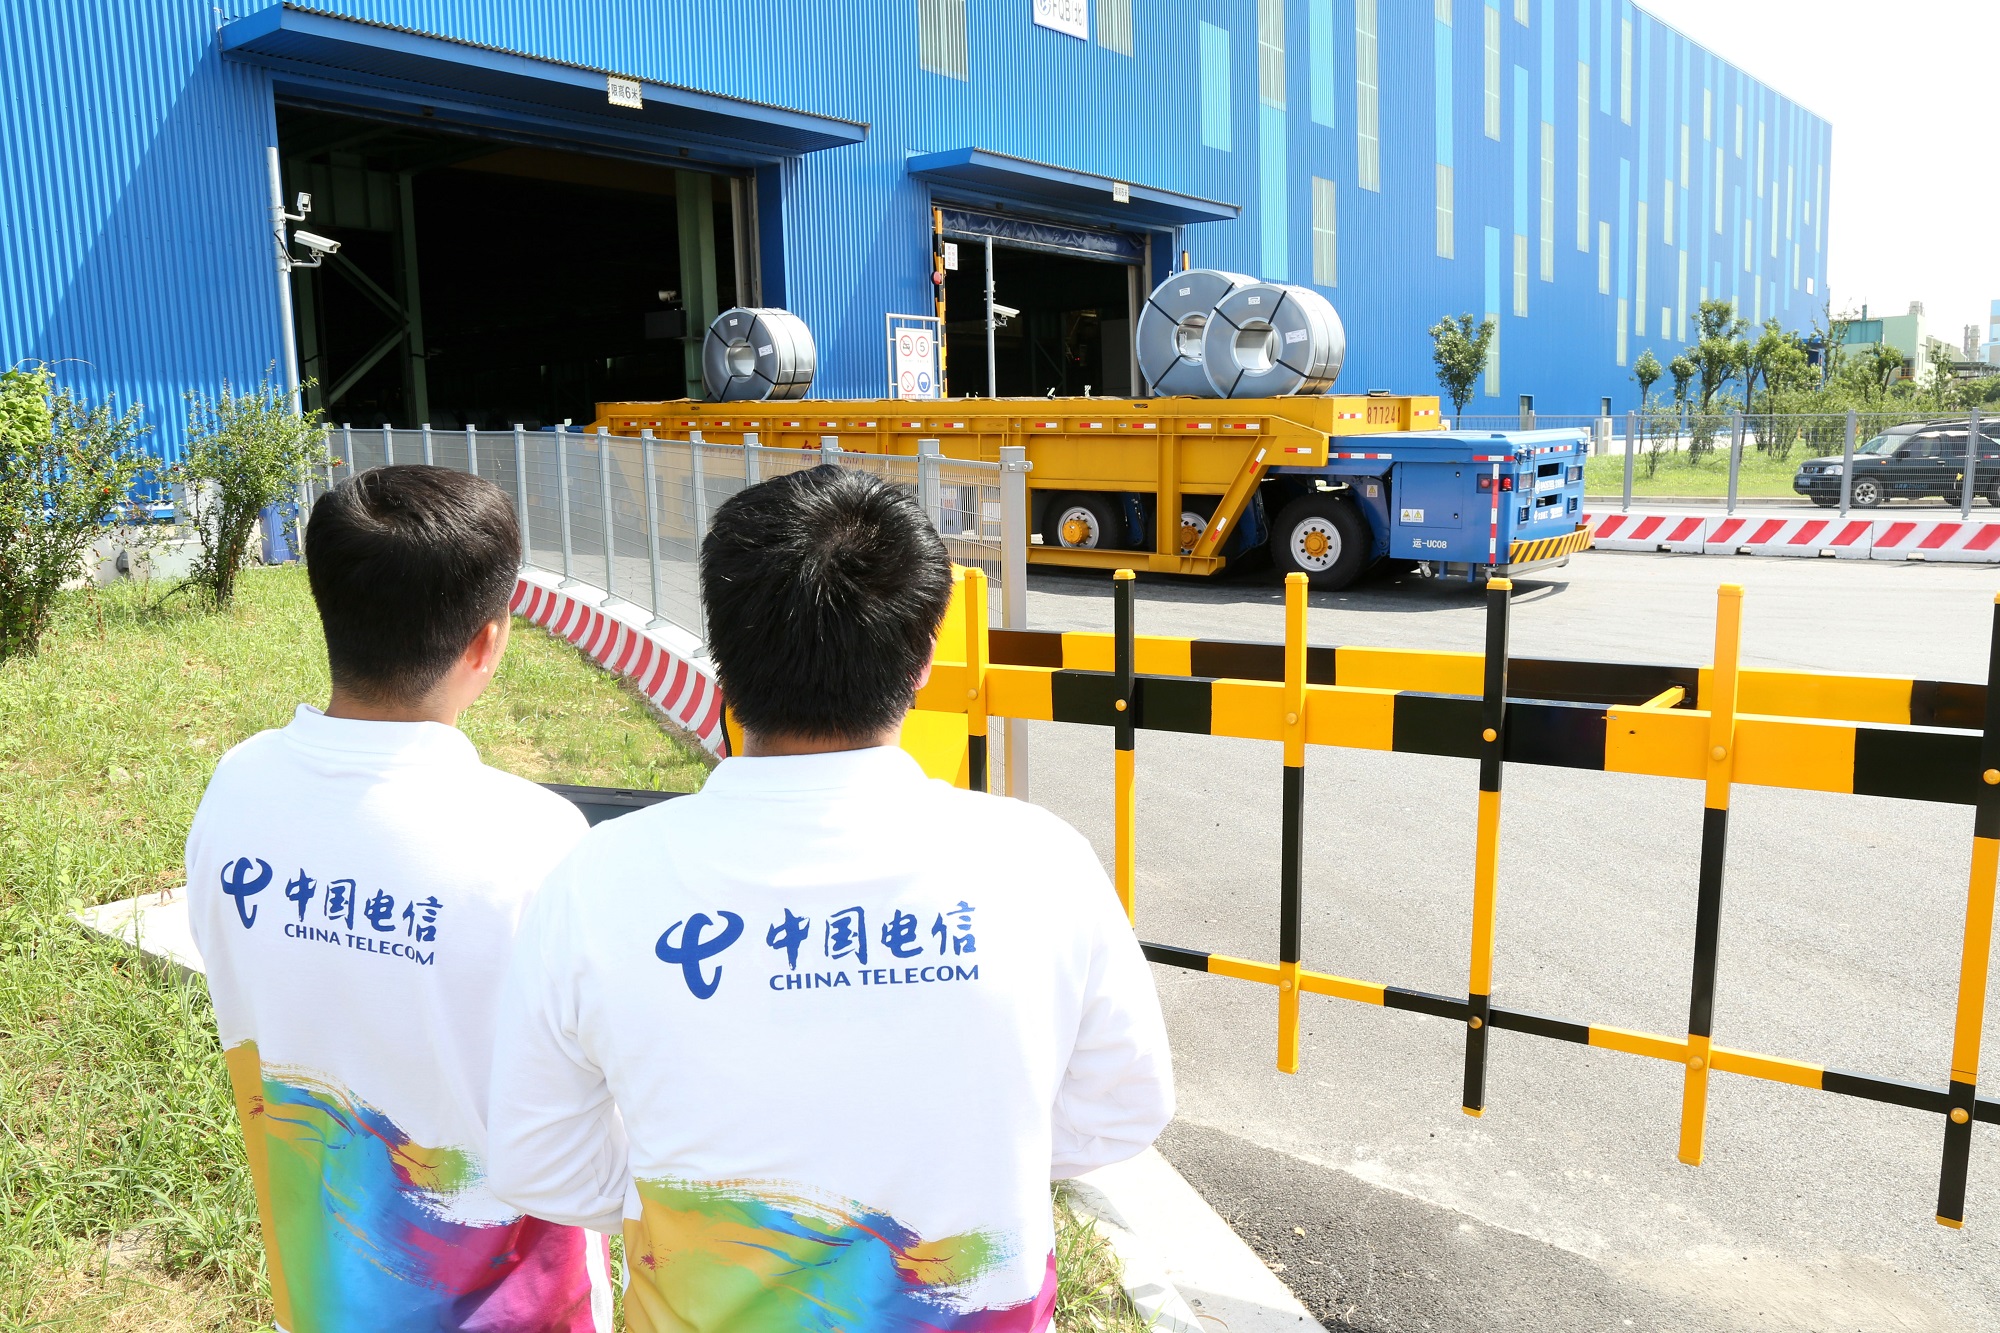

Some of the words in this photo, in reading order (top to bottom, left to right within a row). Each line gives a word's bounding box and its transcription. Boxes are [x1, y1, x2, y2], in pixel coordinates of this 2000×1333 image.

[611, 84, 638, 99] 限高6米
[1367, 406, 1400, 424] 877241
[285, 868, 443, 942] 中国电信
[284, 924, 341, 945] CHINA
[346, 934, 434, 965] TELECOM
[766, 901, 976, 971] 中国电信
[769, 972, 851, 990] CHINA
[858, 964, 979, 985] TELECOM
